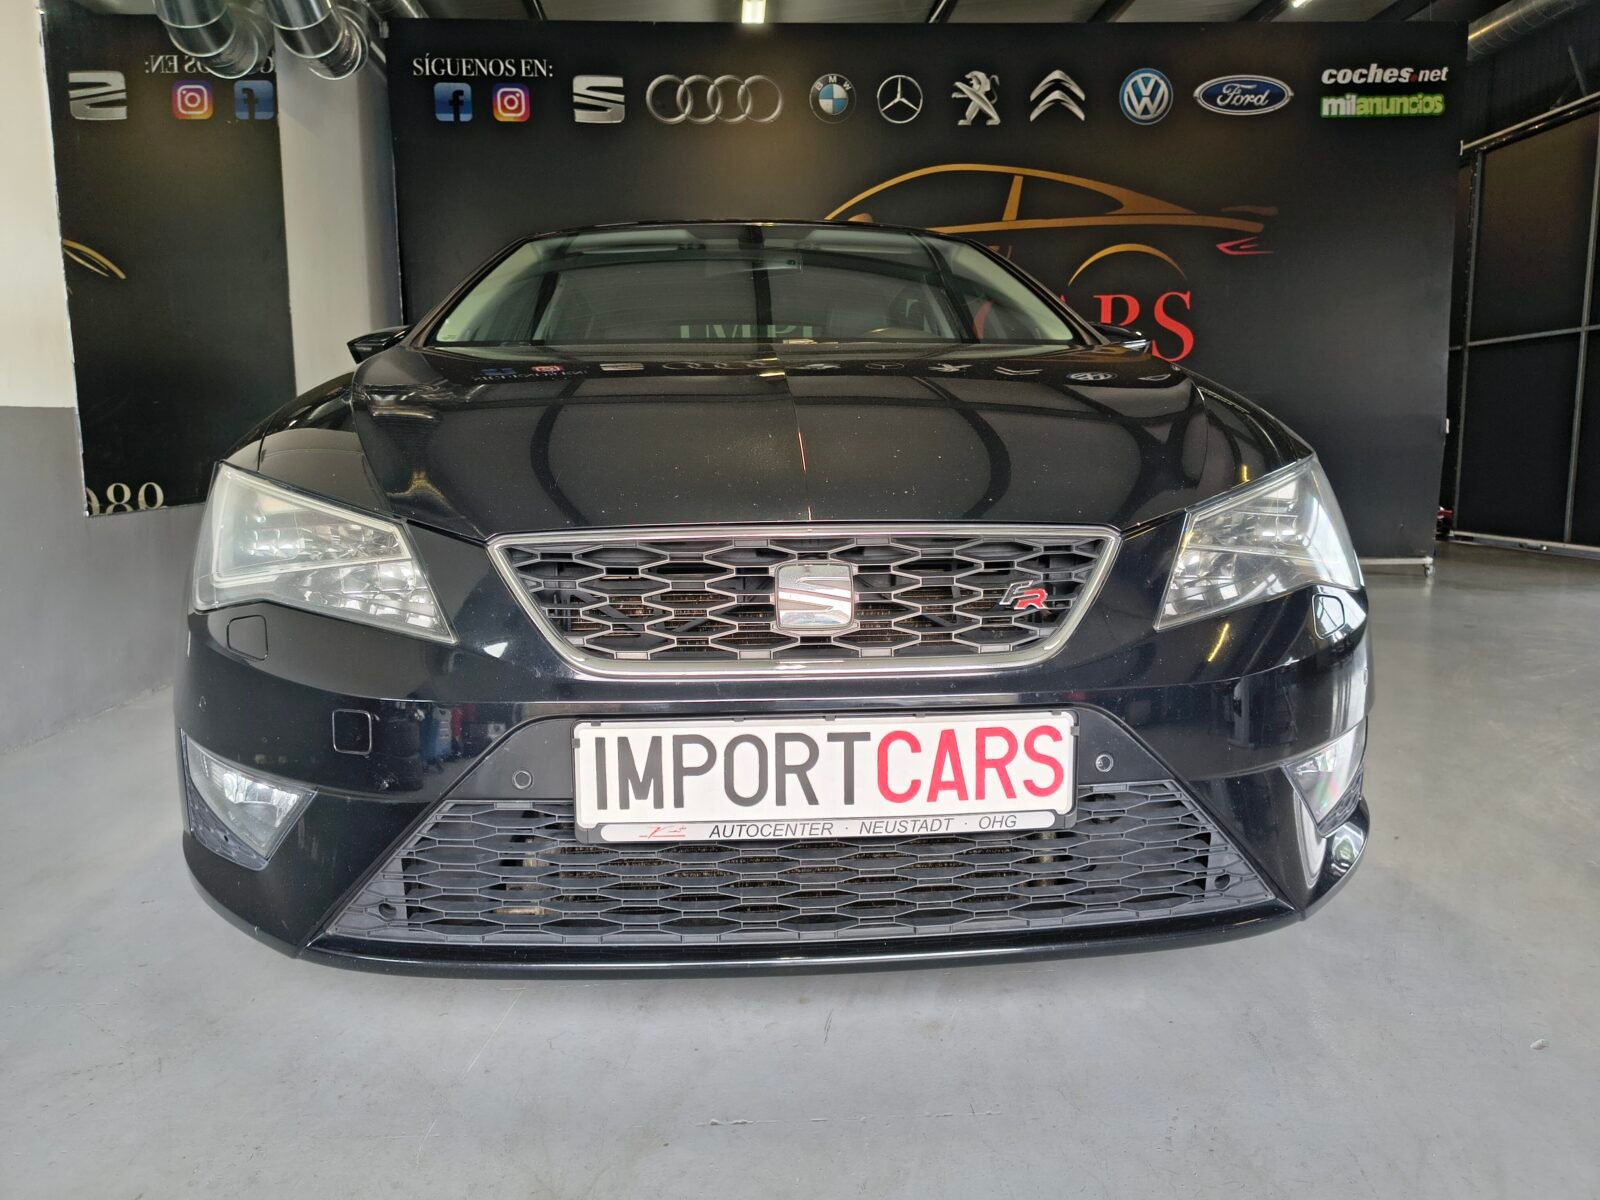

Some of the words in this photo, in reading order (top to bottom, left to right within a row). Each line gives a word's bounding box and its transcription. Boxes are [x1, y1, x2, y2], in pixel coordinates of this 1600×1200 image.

[411, 52, 517, 78] SÍGUENOS
[520, 57, 555, 78] EN:
[1321, 63, 1449, 85] coches.net
[814, 74, 852, 92] BMW
[1216, 83, 1270, 108] Ford
[1321, 93, 1445, 118] milanuncios
[708, 822, 834, 839] AUTOCENTER
[859, 817, 954, 835] NEUSTADT
[978, 814, 1018, 830] OHG
